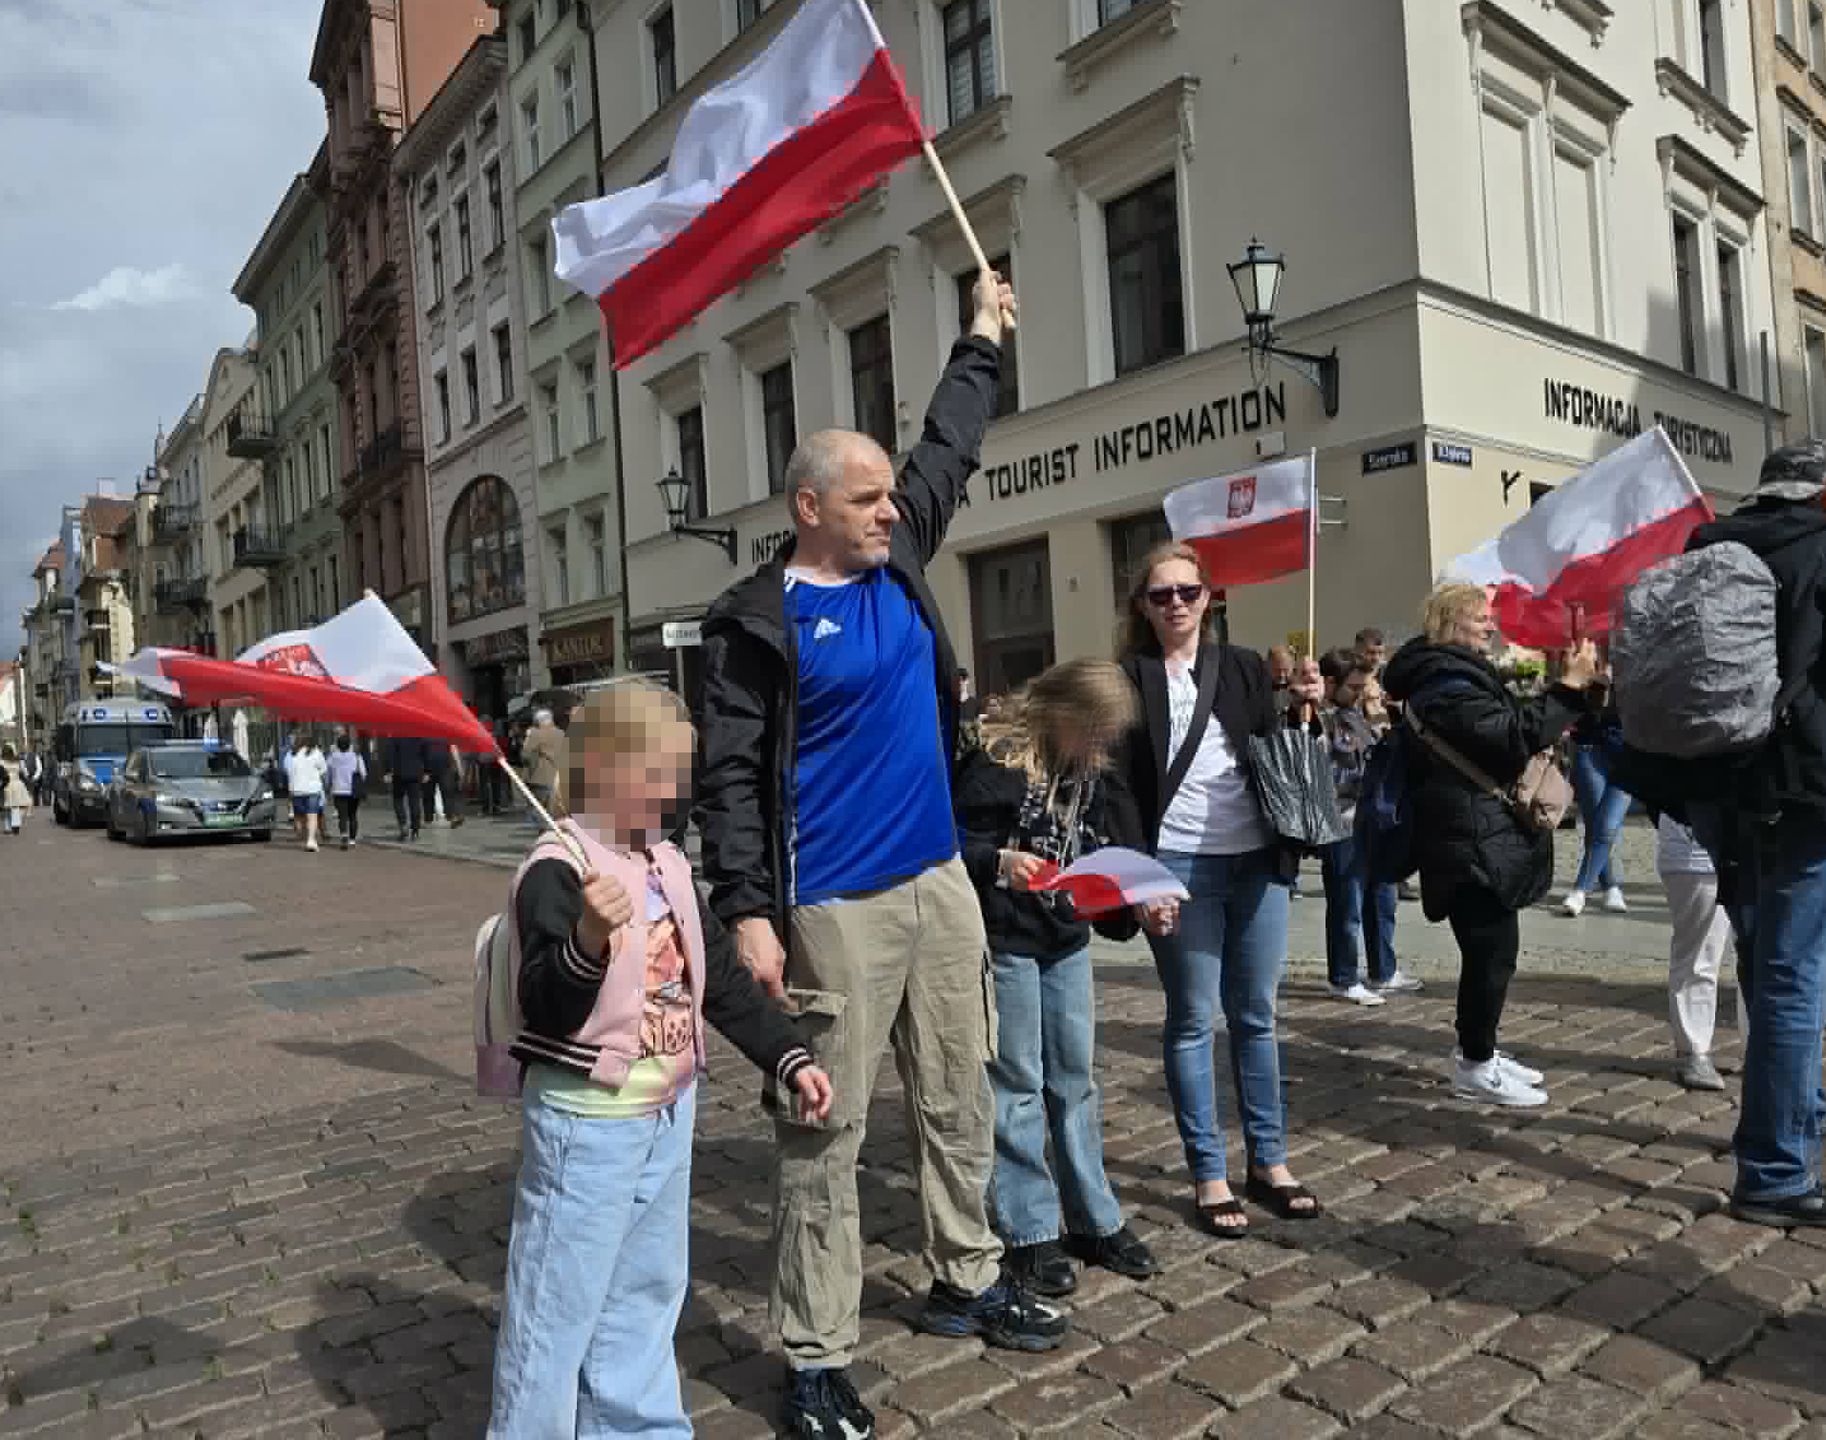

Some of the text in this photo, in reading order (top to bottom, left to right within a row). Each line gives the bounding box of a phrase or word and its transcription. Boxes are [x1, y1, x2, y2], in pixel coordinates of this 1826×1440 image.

[985, 381, 1286, 501] TOURIST INFORMATION
[1543, 377, 1640, 437] INFORMACJA
